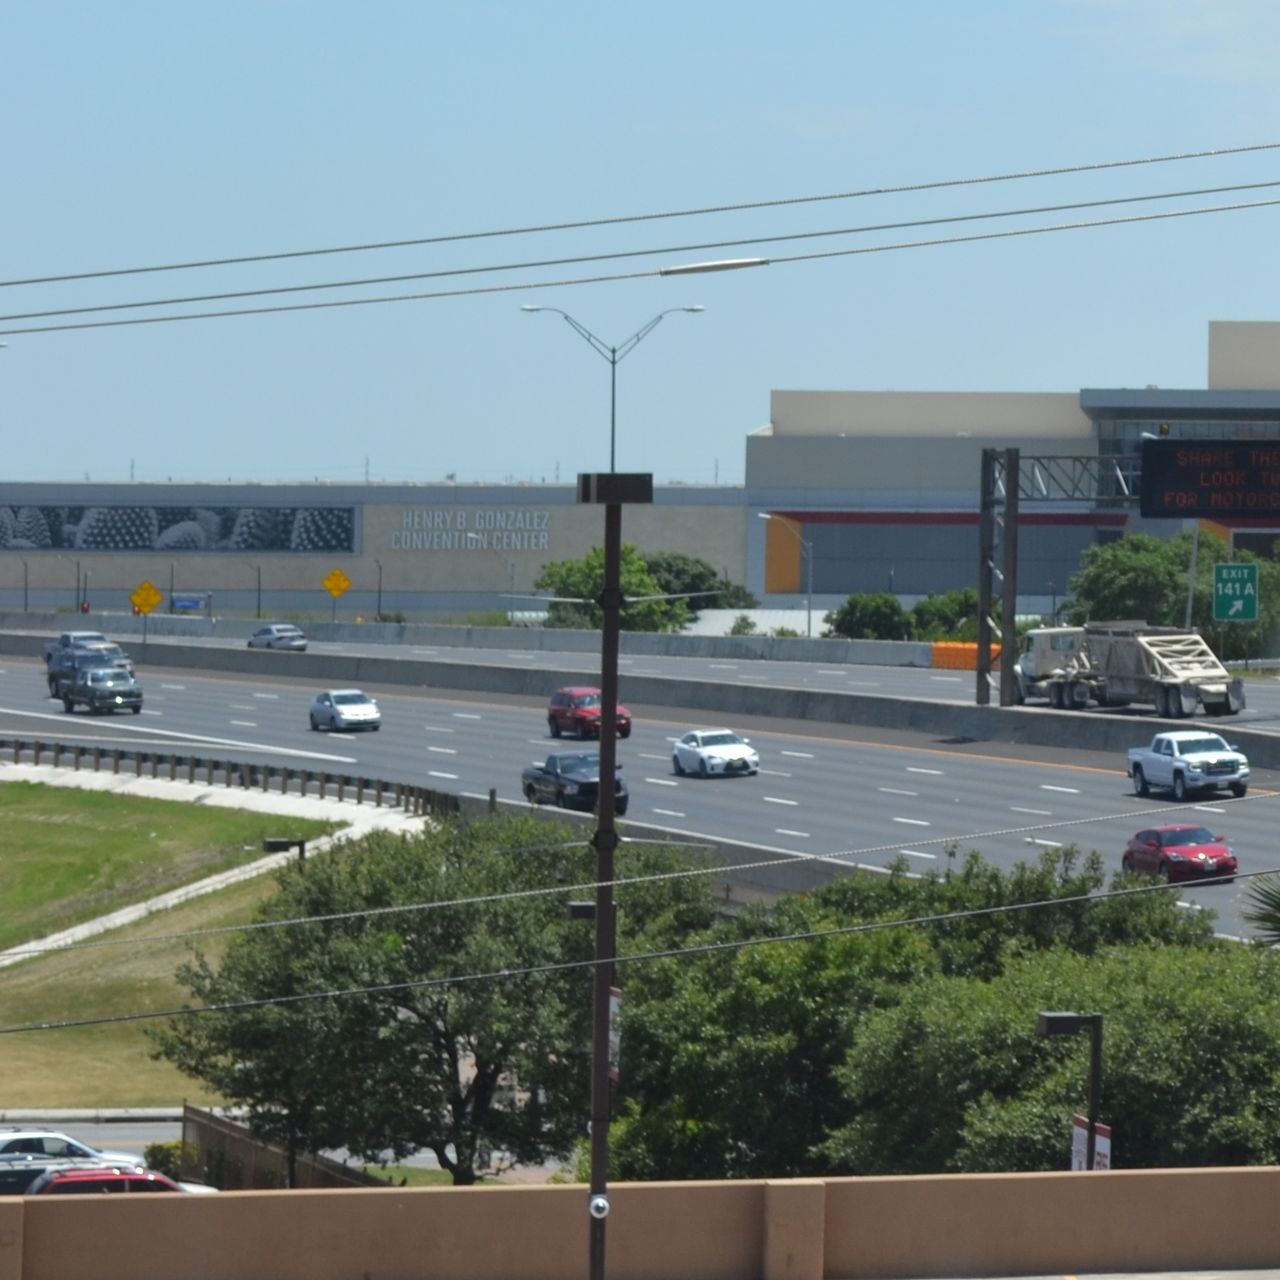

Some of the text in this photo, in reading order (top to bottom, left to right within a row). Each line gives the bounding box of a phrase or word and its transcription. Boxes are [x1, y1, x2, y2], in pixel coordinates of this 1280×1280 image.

[1177, 450, 1235, 467] SHARE
[1200, 471, 1245, 488] LOOK
[1164, 491, 1199, 508] FOR
[403, 511, 451, 529] HENRY
[391, 531, 549, 551] CONVENTION CENTER
[1221, 568, 1249, 580] EXIT
